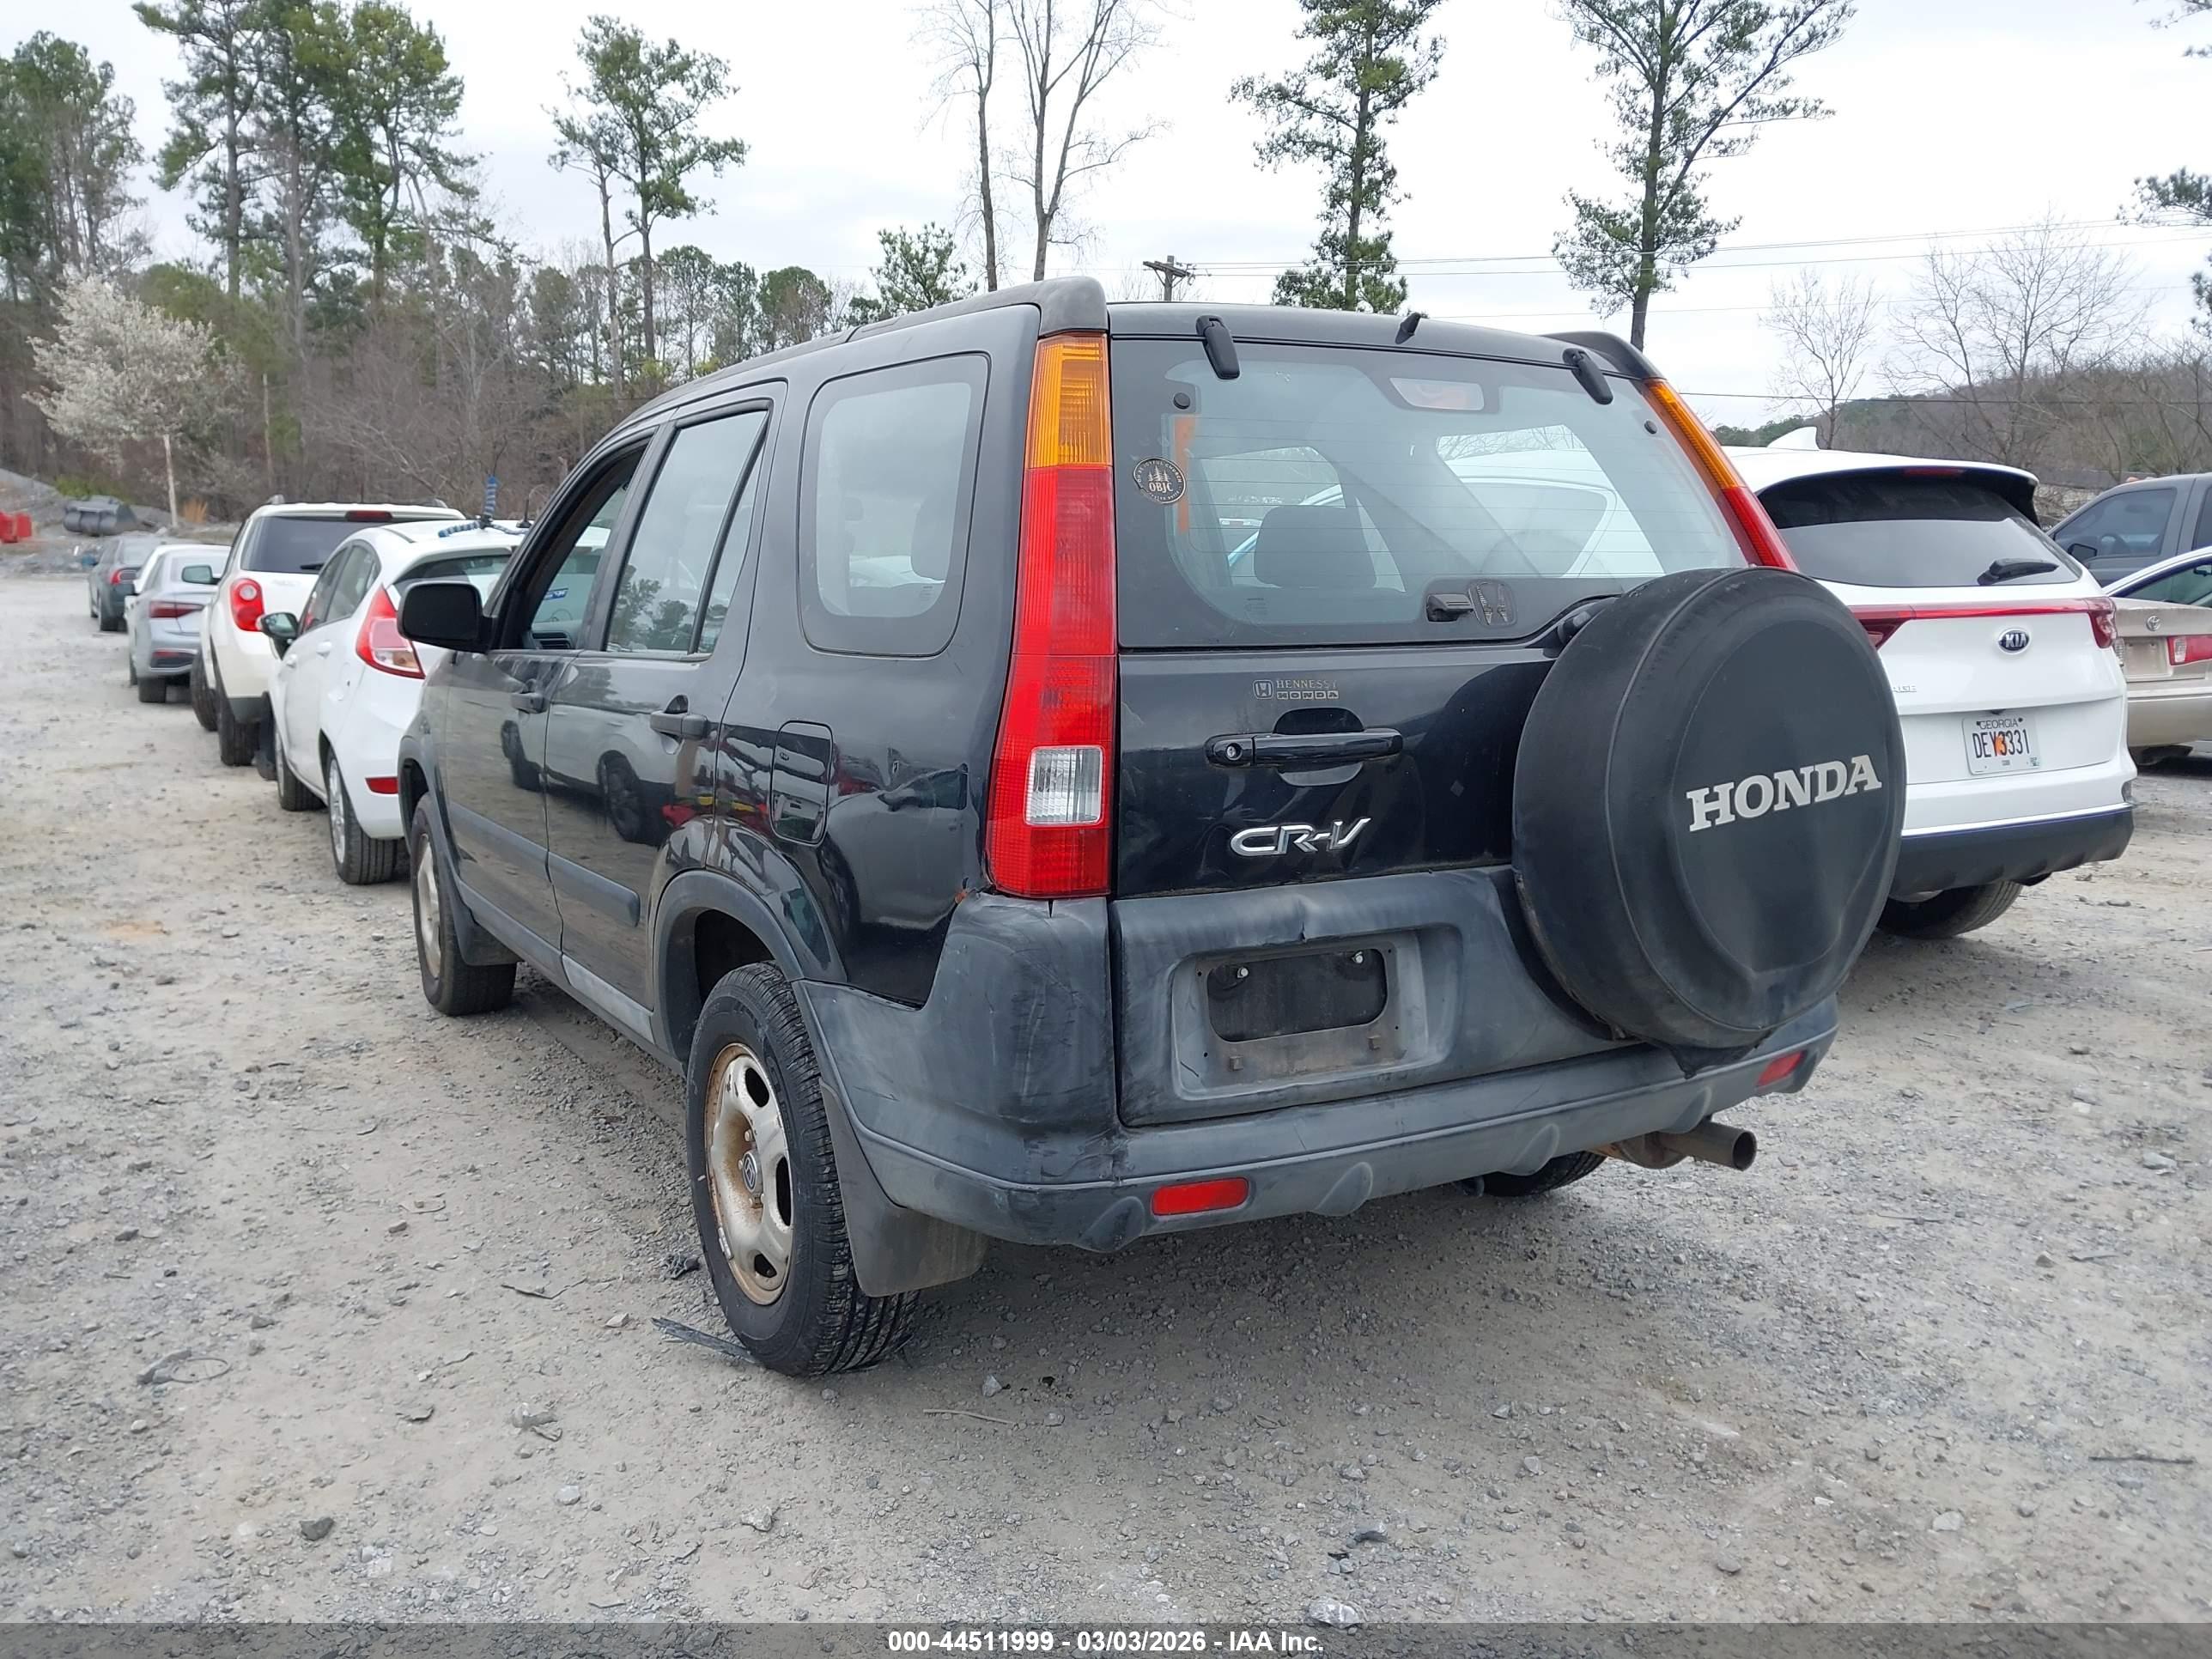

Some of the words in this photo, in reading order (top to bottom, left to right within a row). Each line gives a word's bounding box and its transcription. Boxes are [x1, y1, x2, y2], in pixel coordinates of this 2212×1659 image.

[1149, 482, 1173, 494] OBJC
[2005, 633, 2027, 647] KIA
[1276, 690, 1340, 700] HONDA
[1979, 719, 2019, 730] GEORGIA
[1972, 728, 2030, 759] DEY3331
[1686, 754, 1882, 832] HONDA
[1230, 817, 1372, 857] CR-V
